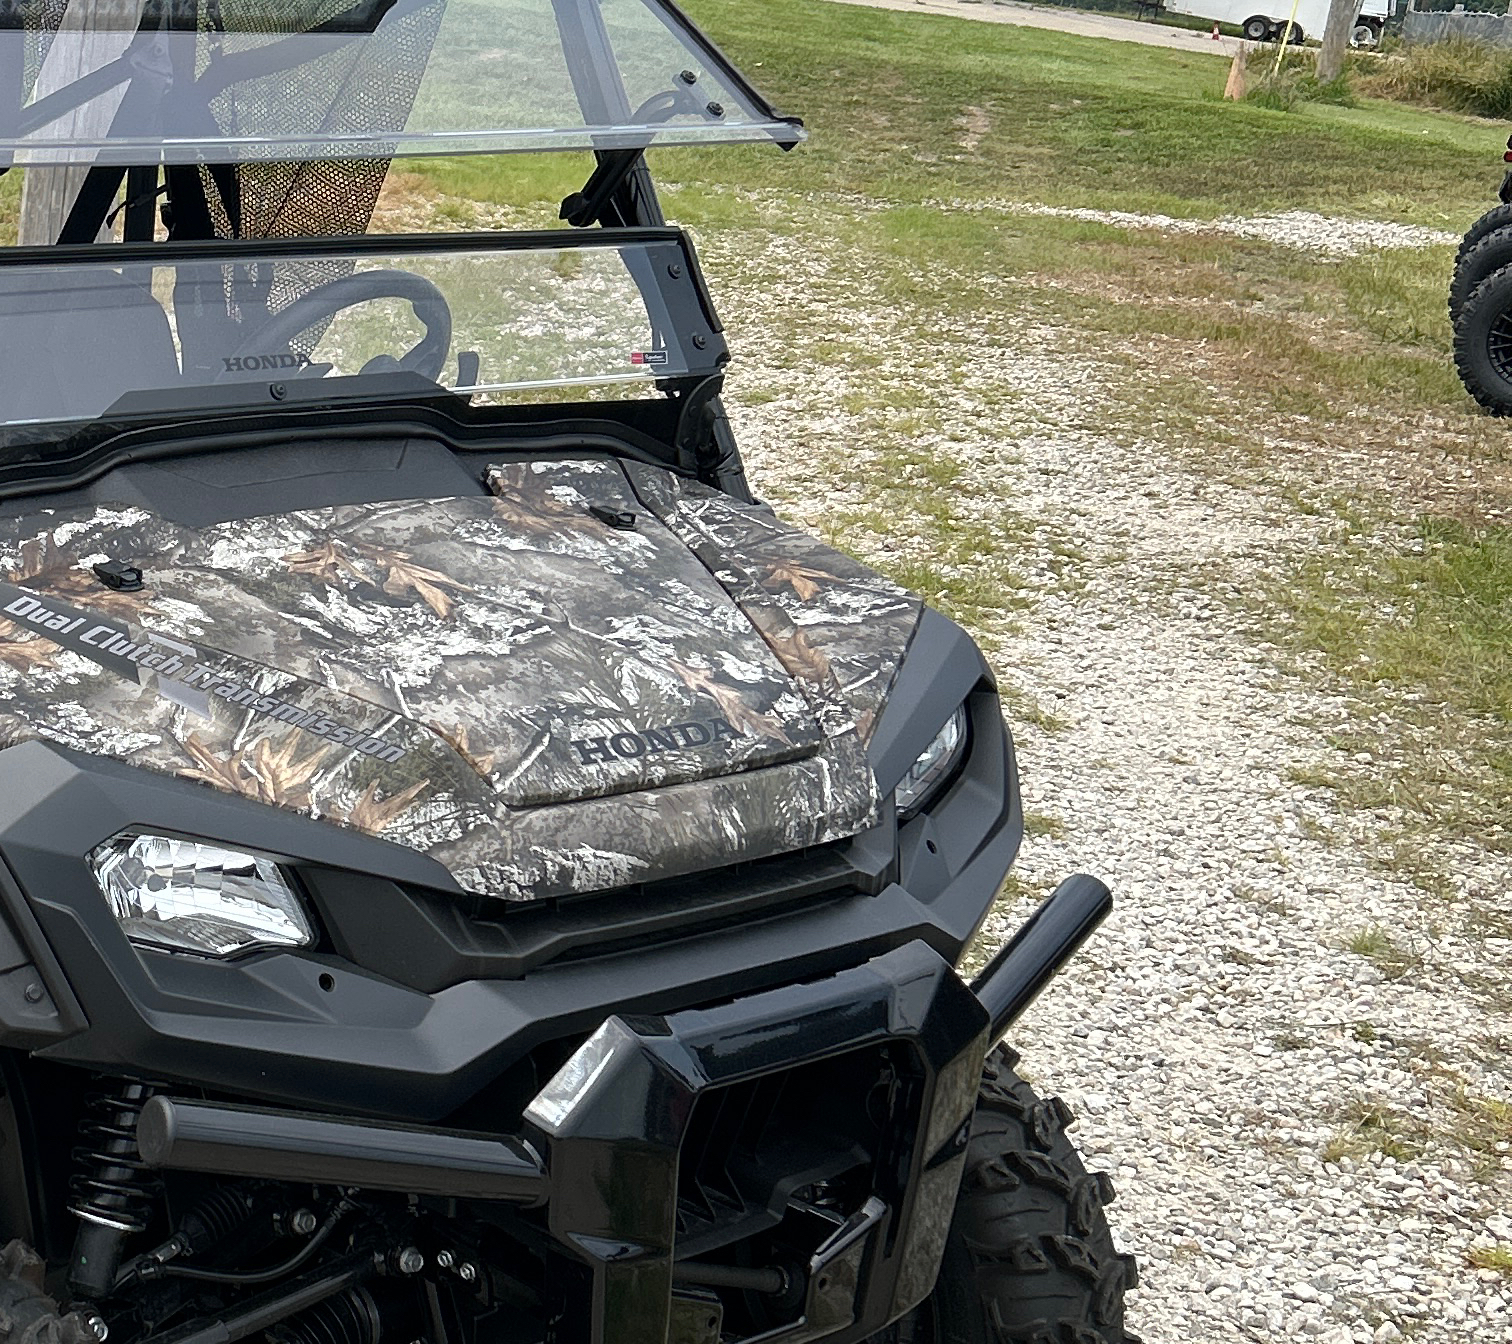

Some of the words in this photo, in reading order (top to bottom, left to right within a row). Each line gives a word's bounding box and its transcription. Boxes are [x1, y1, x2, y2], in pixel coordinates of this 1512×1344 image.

[222, 353, 316, 372] HONDA
[3, 595, 87, 635] Dual
[79, 624, 185, 676] Clutch
[181, 662, 406, 763] Transmission
[570, 717, 746, 765] HONDA
